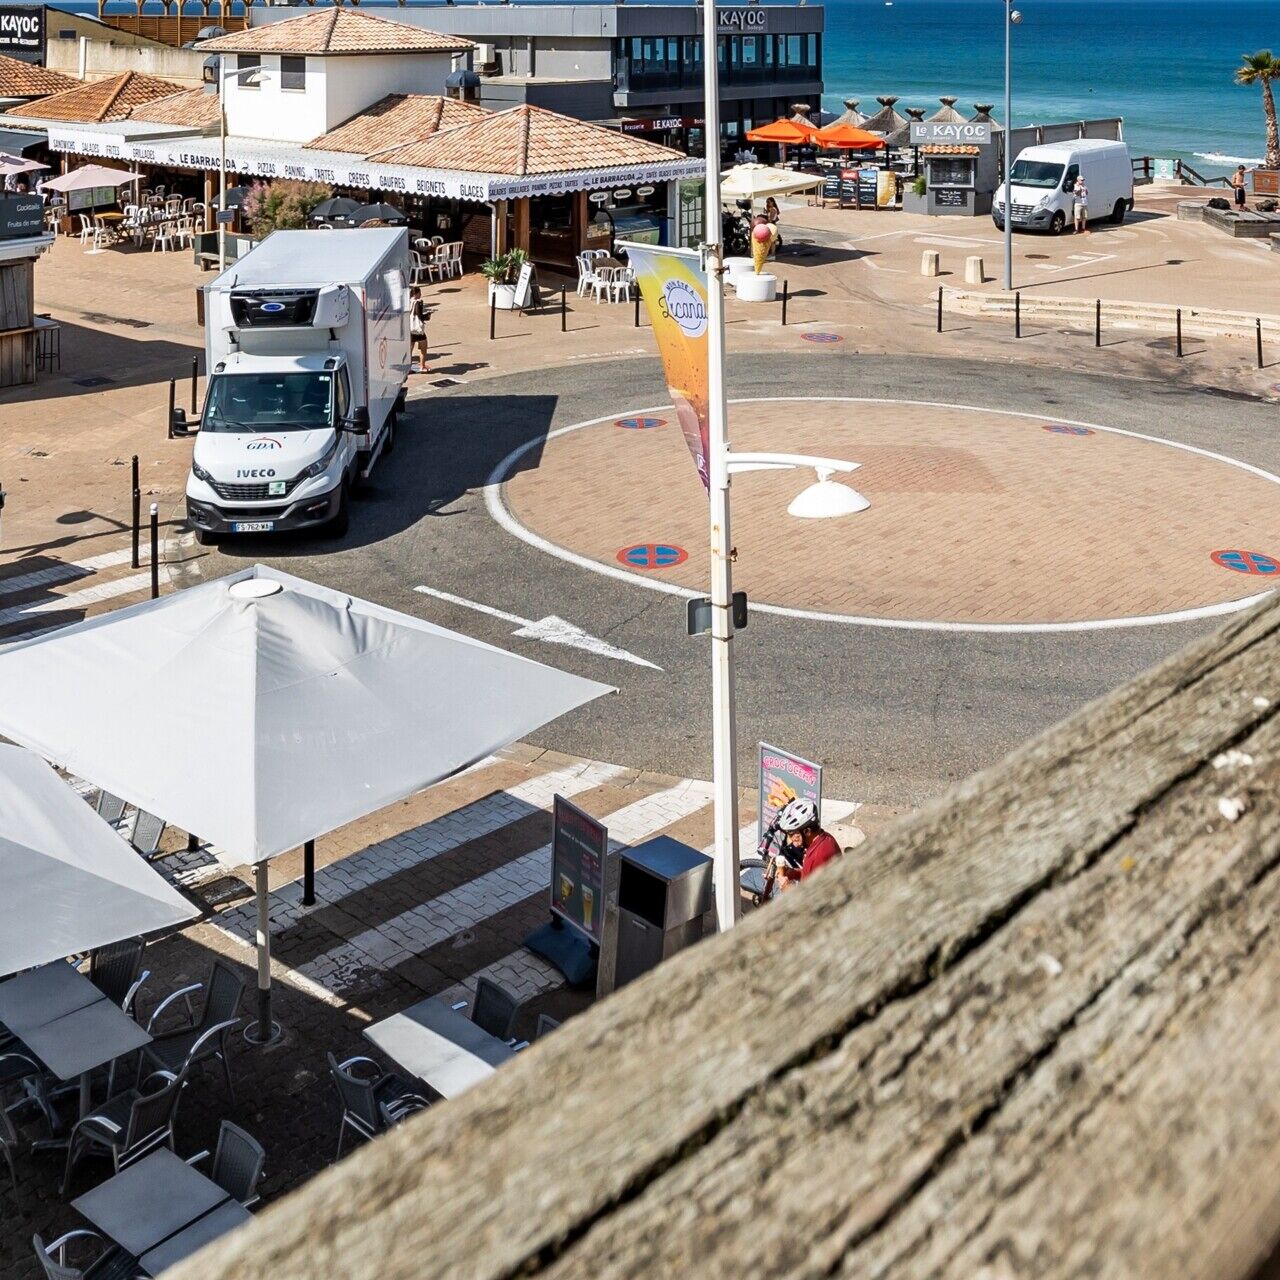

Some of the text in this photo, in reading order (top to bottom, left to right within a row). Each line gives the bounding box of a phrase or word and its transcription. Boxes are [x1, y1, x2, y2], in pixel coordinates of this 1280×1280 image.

[1, 15, 39, 38] KAYOC
[720, 10, 766, 31] KAYOC
[653, 120, 661, 130] LE
[661, 118, 682, 129] KAYOC
[915, 125, 985, 140] Le KAYOC
[105, 144, 120, 156] FRITES
[132, 148, 155, 160] GRILLADES
[179, 153, 189, 165] LE
[190, 154, 237, 170] BARRACDA
[257, 161, 276, 174] PIZZAS
[284, 164, 306, 178] PANINIS
[313, 168, 335, 181] TARTES
[378, 174, 407, 190] GAUFRES
[416, 179, 447, 195] BEIGNETS
[459, 183, 485, 199] GLACES
[591, 176, 599, 185] LE
[599, 173, 636, 184] BARRACUDA
[16, 204, 41, 212] Cocktails
[7, 220, 22, 228] Fruits
[246, 442, 274, 450] GDA
[236, 468, 276, 478] IVECO
